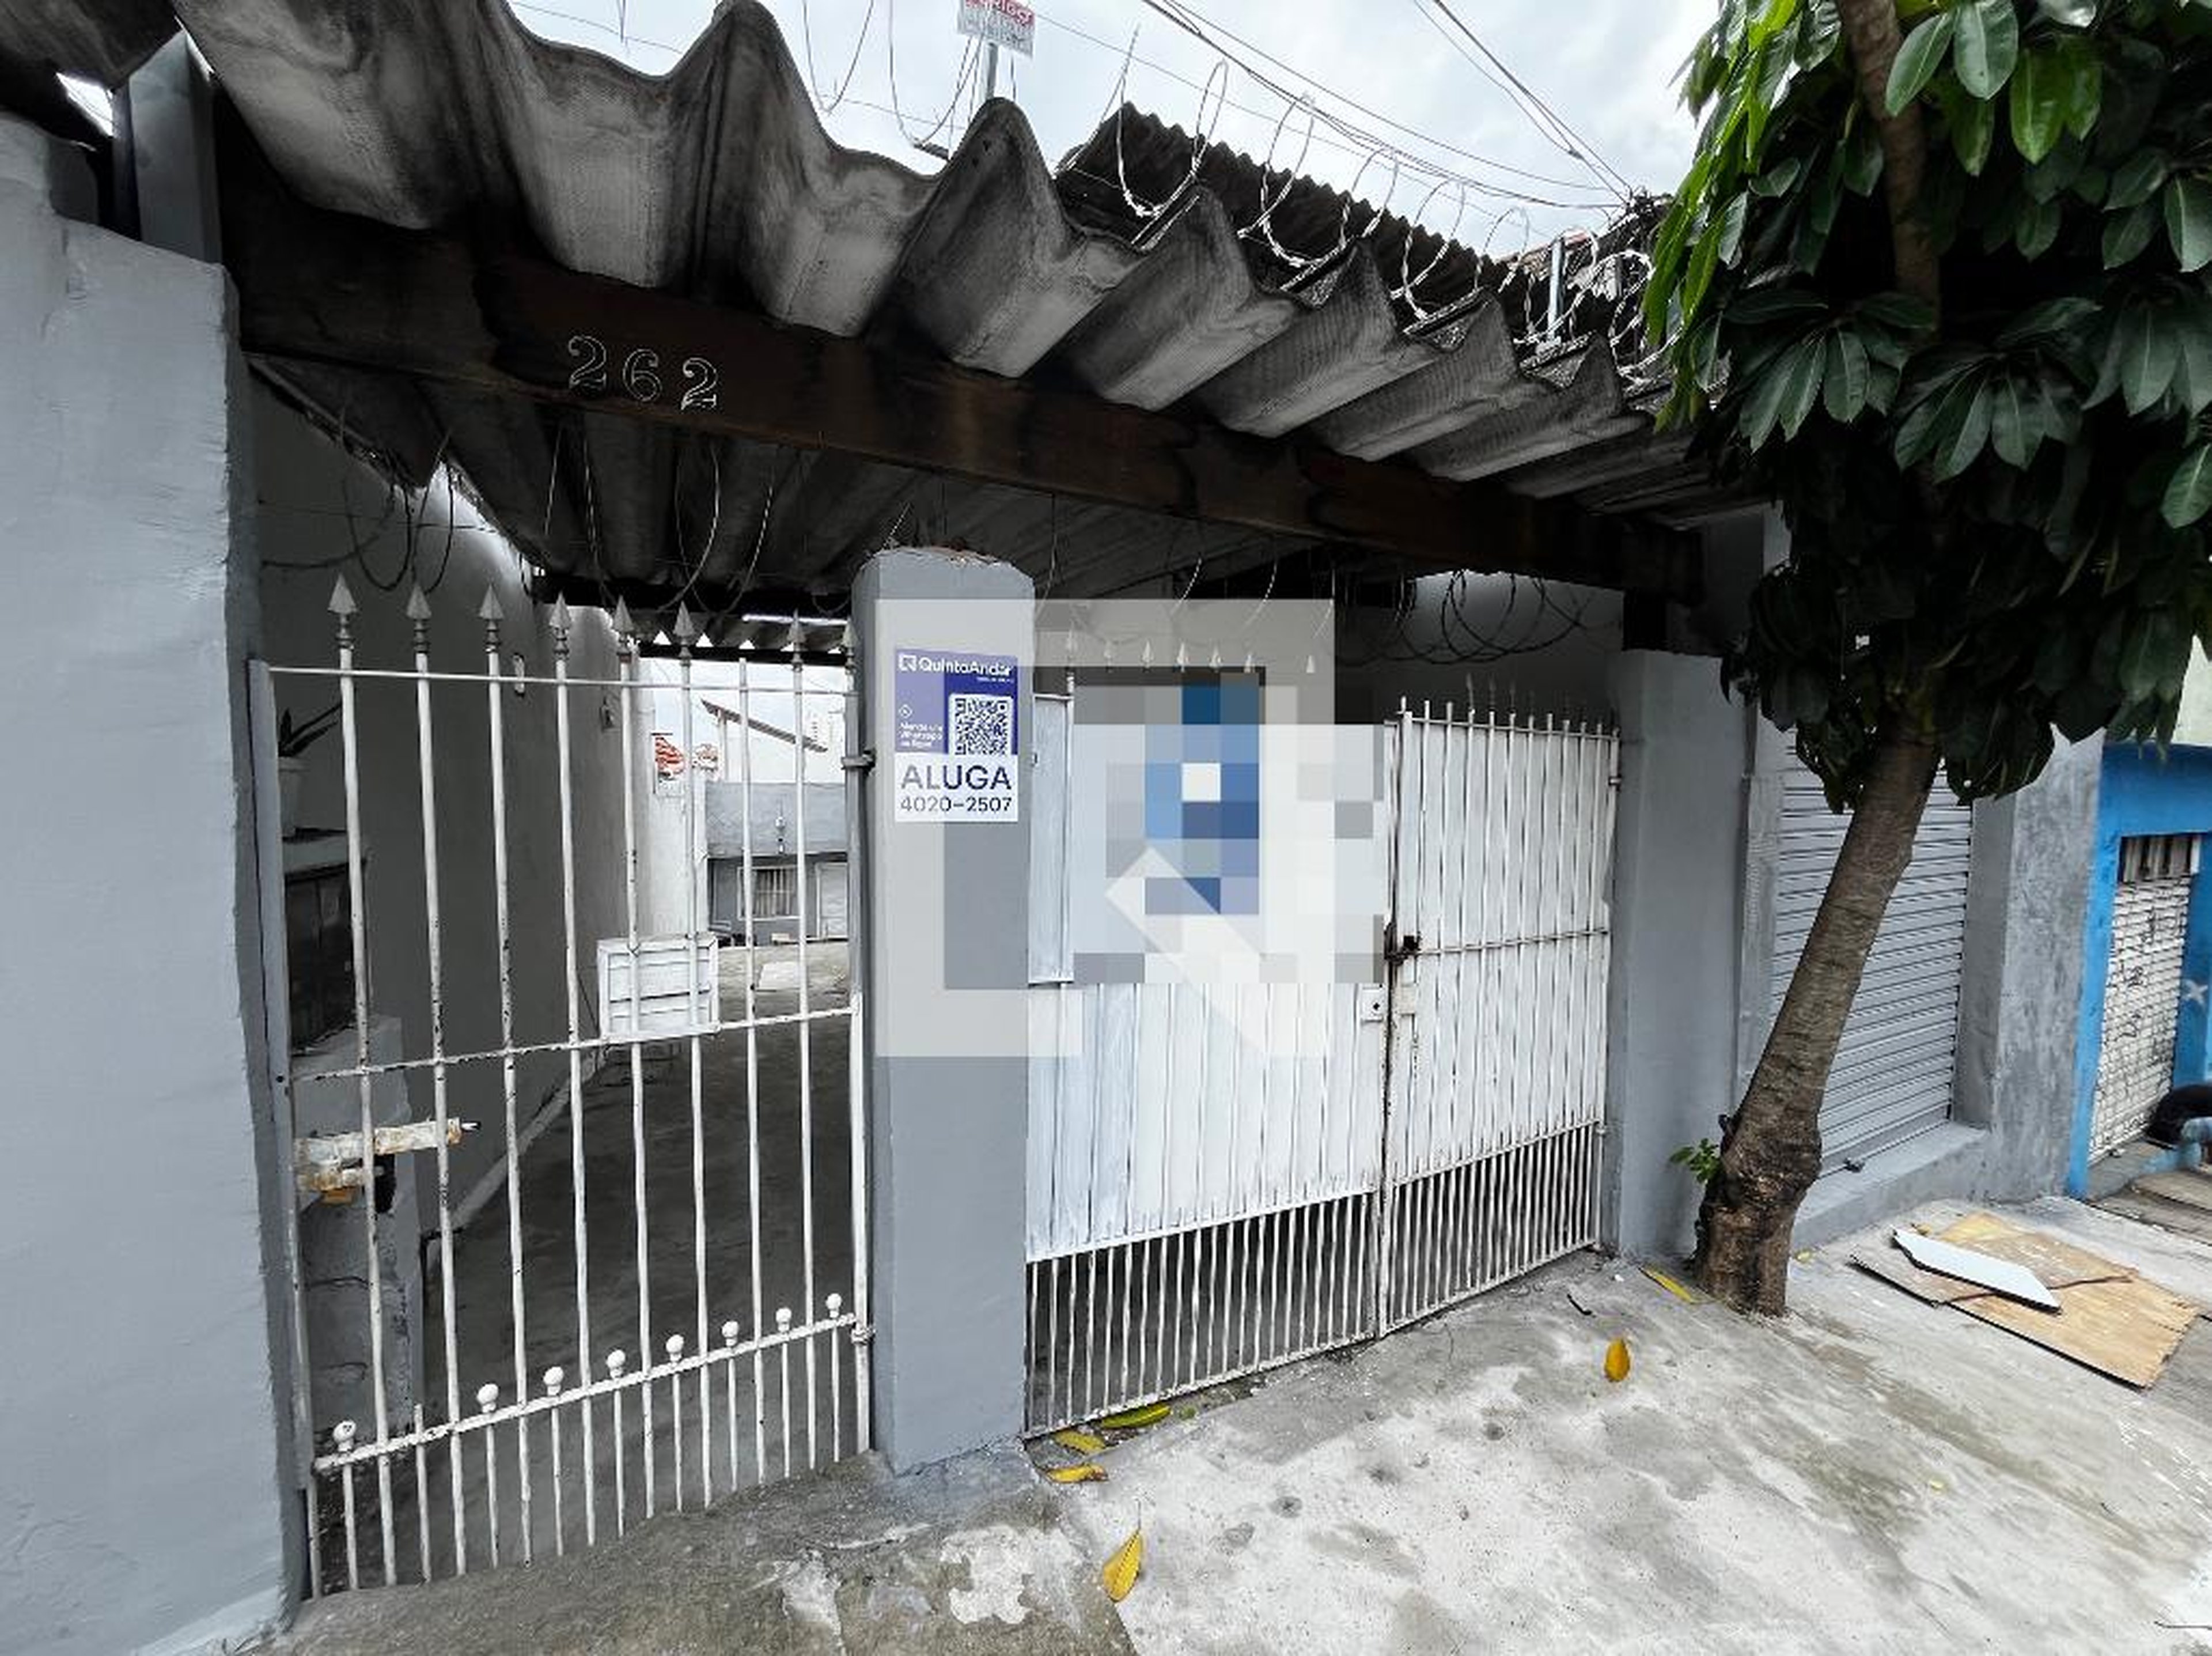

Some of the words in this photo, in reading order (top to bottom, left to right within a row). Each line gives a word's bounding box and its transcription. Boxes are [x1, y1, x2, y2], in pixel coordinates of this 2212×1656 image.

[569, 335, 719, 410] 262
[919, 657, 1012, 676] QuintoAndar
[901, 765, 1012, 789] ALUGA
[900, 796, 1012, 812] 4020-2507
